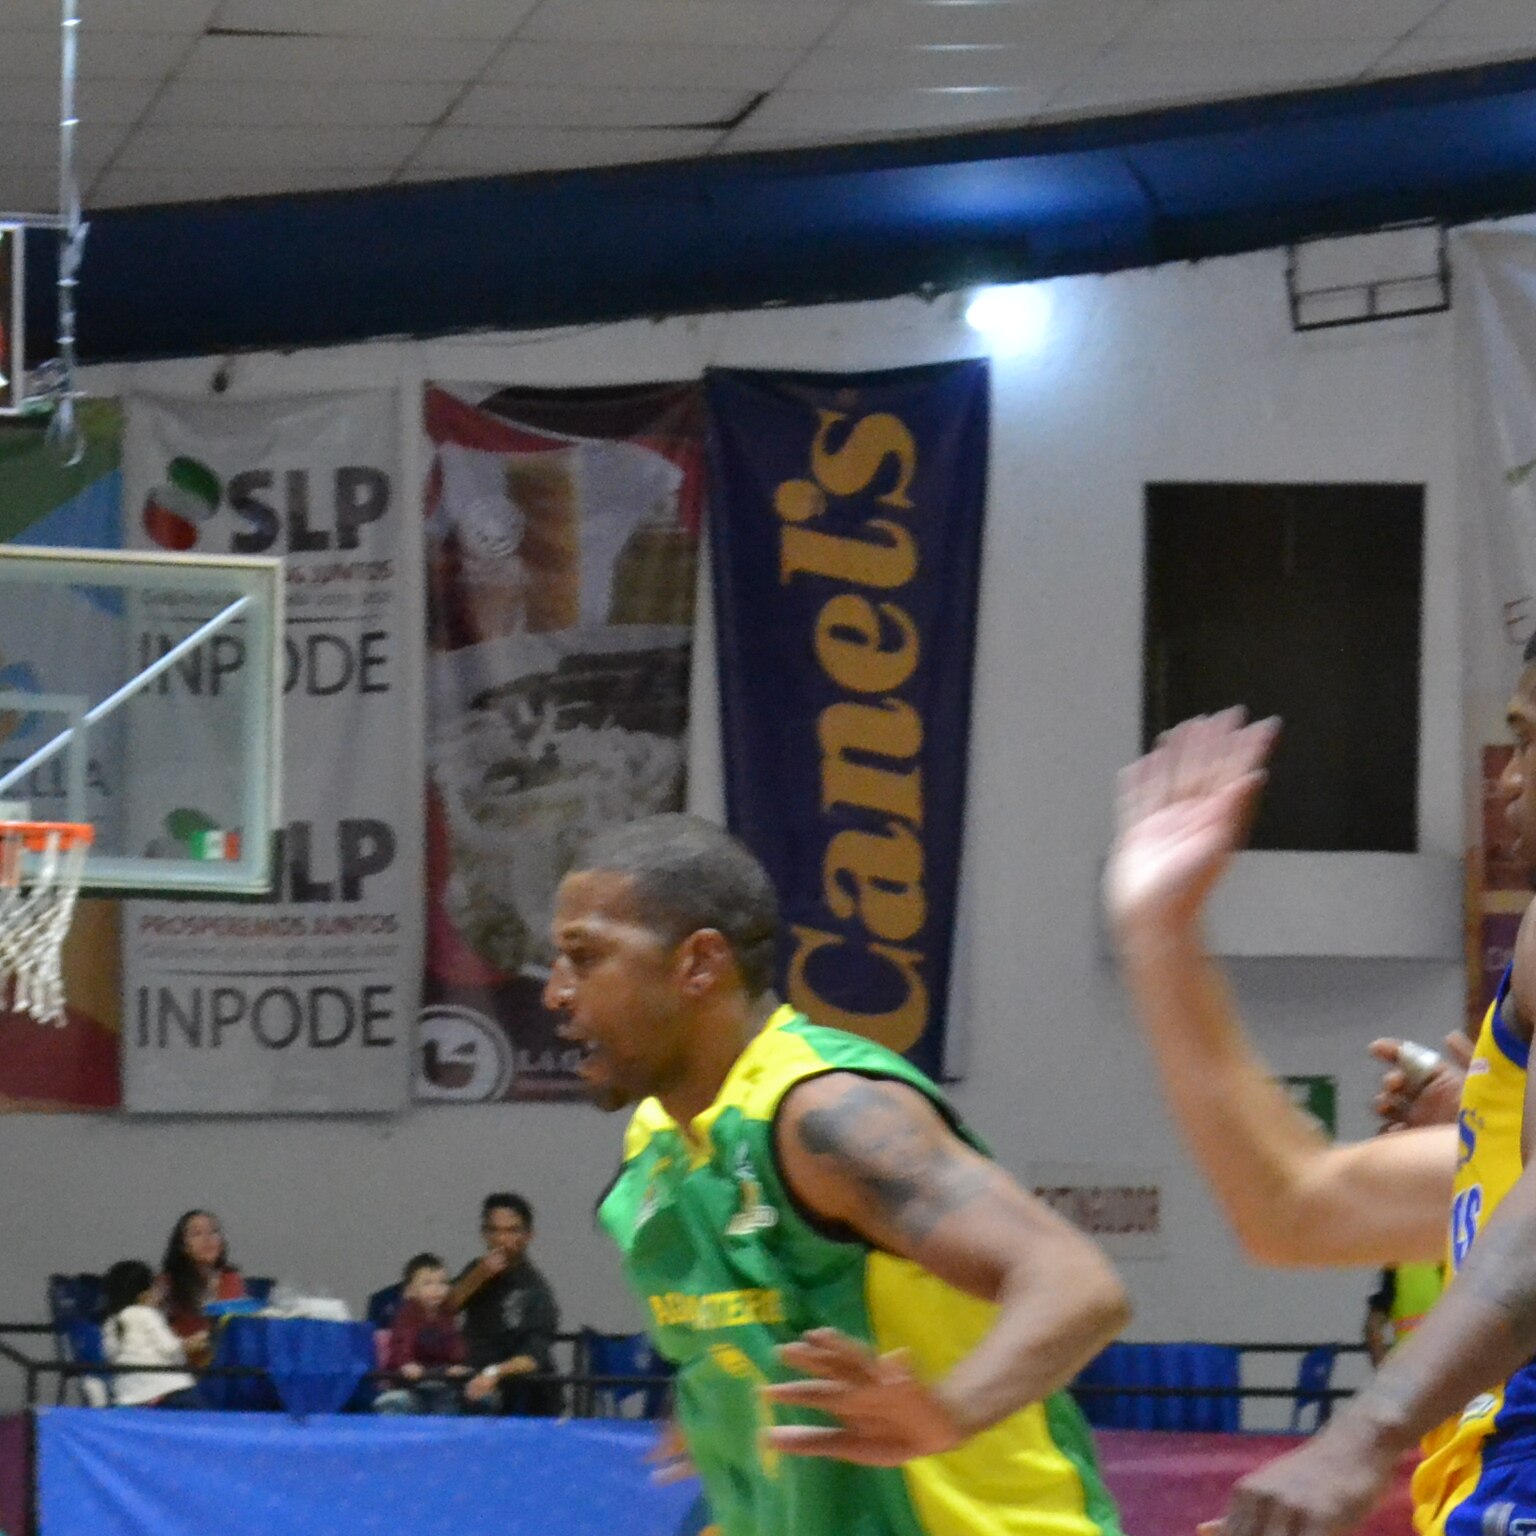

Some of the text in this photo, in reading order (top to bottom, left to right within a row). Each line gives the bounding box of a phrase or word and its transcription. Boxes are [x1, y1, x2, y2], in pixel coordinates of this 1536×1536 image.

[226, 465, 392, 553] SLP
[286, 818, 399, 904] LP
[135, 983, 398, 1050] INPODE
